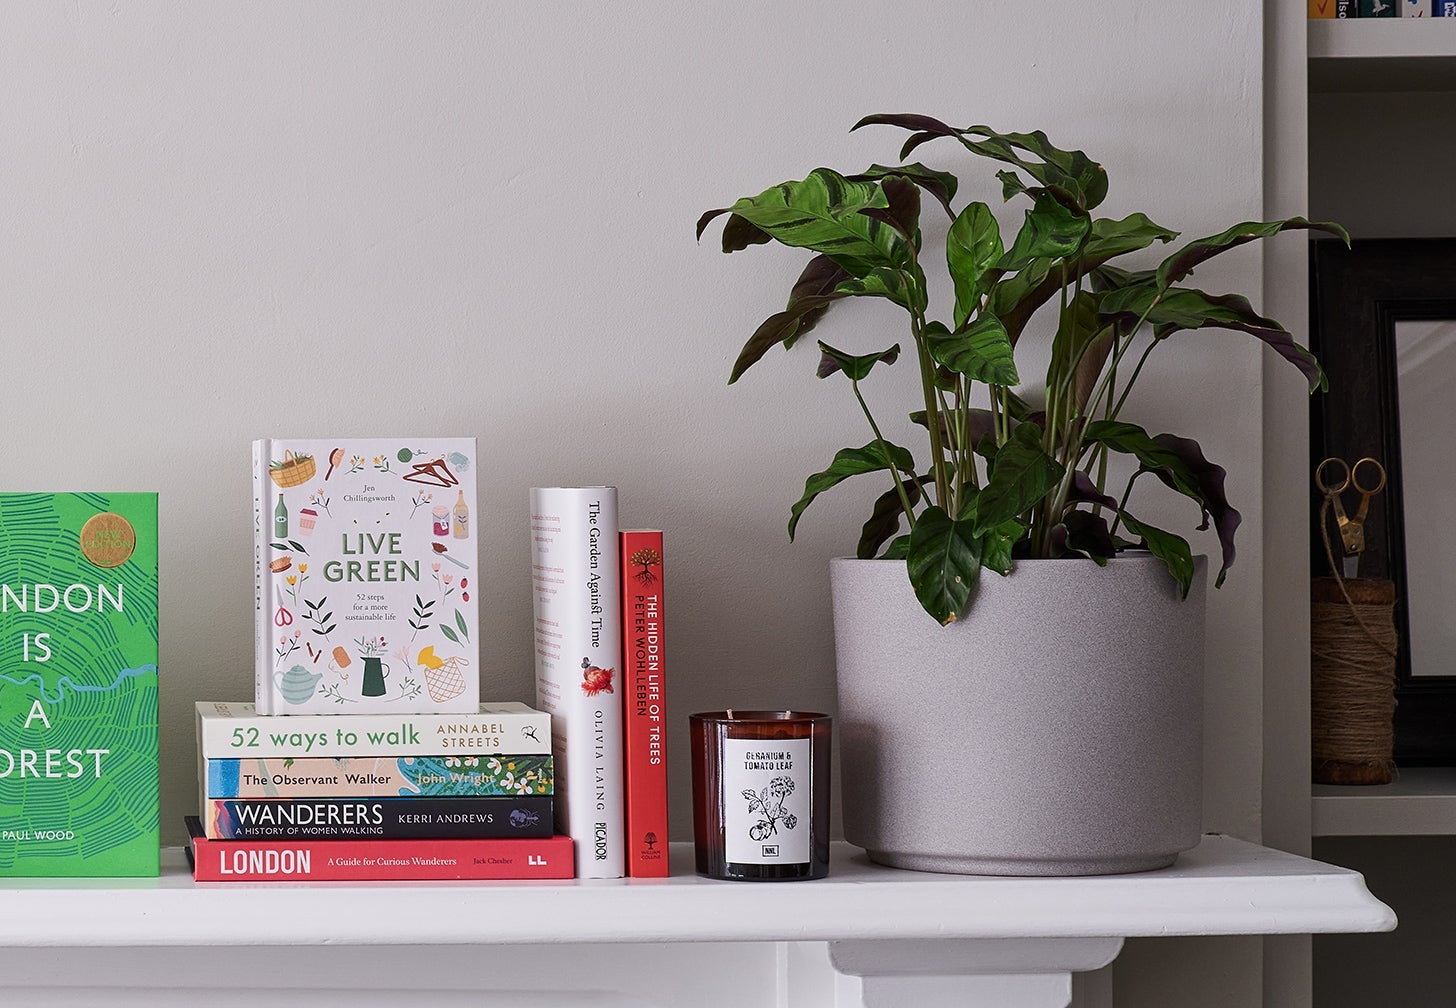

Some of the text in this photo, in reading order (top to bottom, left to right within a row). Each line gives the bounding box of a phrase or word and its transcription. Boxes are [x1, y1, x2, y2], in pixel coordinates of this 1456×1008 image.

[344, 495, 395, 503] Chillingsworth
[363, 485, 375, 493] Jen
[343, 533, 402, 555] LIVE
[323, 560, 420, 582] GREEN
[587, 501, 603, 648] The Garden Against Time
[23, 633, 51, 662] IS
[635, 595, 646, 716] PETER WOHLLEBEN
[647, 595, 660, 765] THE HIDDEN LIFE OF TREES
[24, 700, 51, 729] A
[231, 724, 420, 752] 52 ways to walk
[437, 724, 505, 734] ANNABEL
[442, 737, 500, 748] STREETS
[594, 710, 605, 810] OLIVIA LAING
[744, 762, 793, 770] TOMATO LEAF
[746, 751, 784, 760] GERANIUM
[243, 774, 391, 786] The Observant Walker
[417, 772, 495, 786] John Wright
[235, 804, 383, 825] WANDERERS
[398, 814, 493, 823] KERRI ANDREWS
[2, 830, 74, 841] PAUL WOOD
[235, 827, 384, 835] A HISTORY OF WOMEN WALKING
[595, 822, 607, 860] PICADOR
[220, 850, 456, 874] LONDON A Guide for Curious Wanderers
